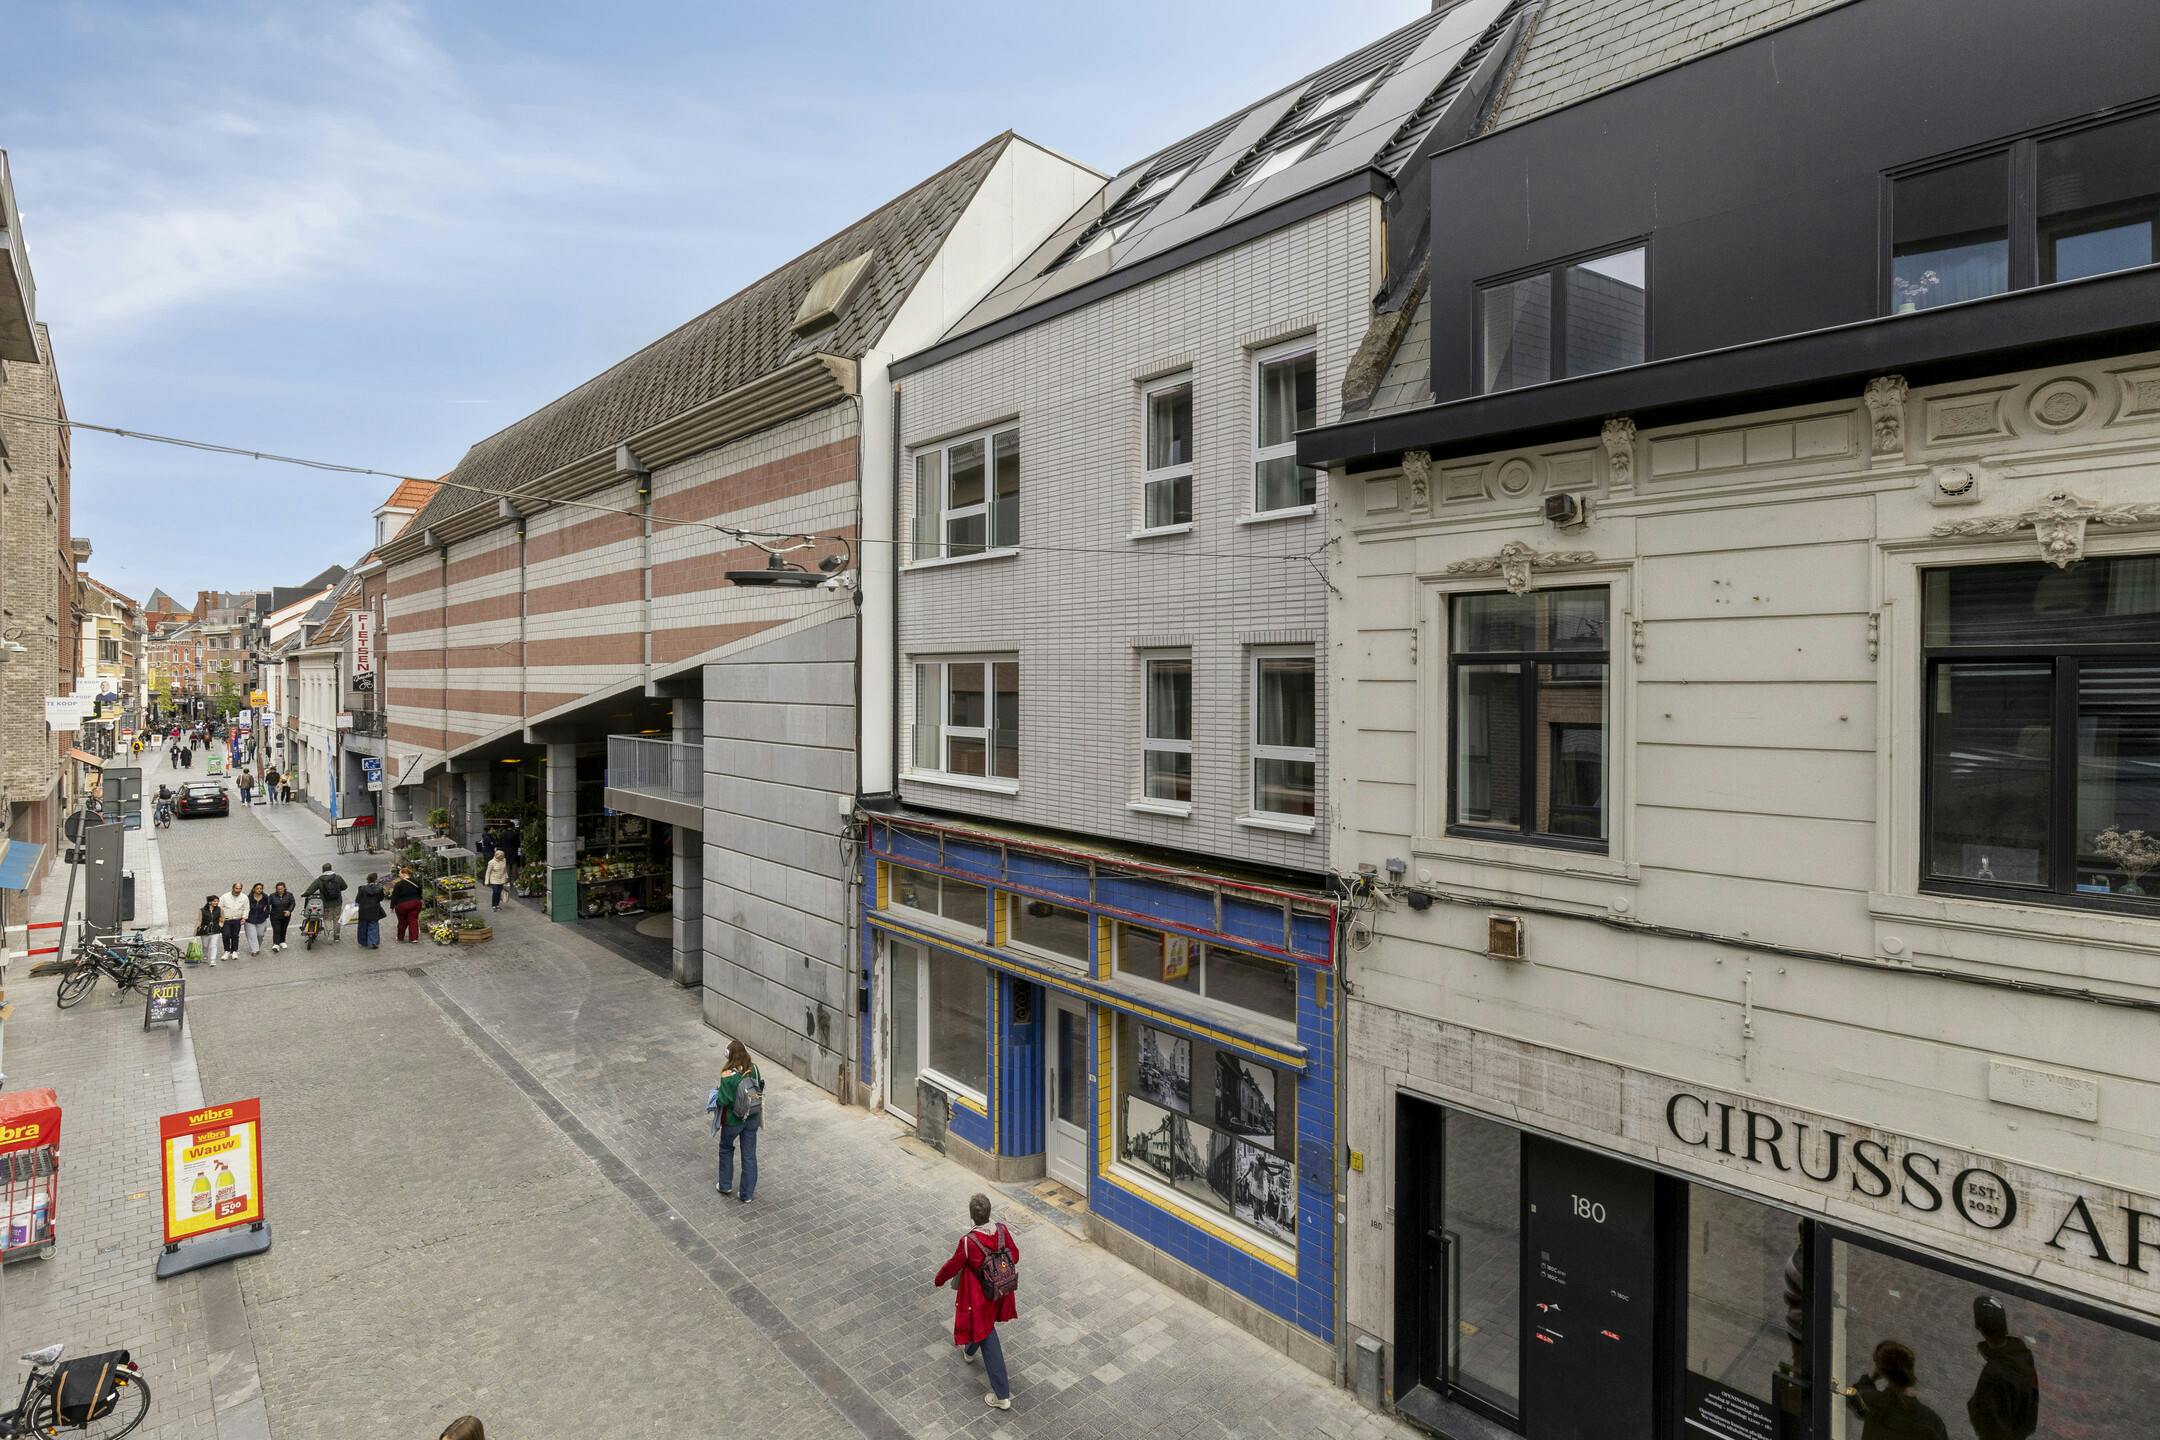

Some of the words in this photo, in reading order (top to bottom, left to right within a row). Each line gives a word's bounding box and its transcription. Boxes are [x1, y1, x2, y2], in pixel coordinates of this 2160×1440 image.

[358, 614, 370, 672] FIETSEN
[188, 1108, 233, 1124] wibra
[197, 1130, 226, 1140] wibra
[190, 1140, 234, 1158] Wauw
[1666, 1093, 2017, 1229] CIRUSSO
[1968, 1182, 2000, 1200] EST.
[1571, 1194, 1606, 1224] 180
[1969, 1200, 1998, 1215] 2021
[1371, 1219, 1383, 1231] 180
